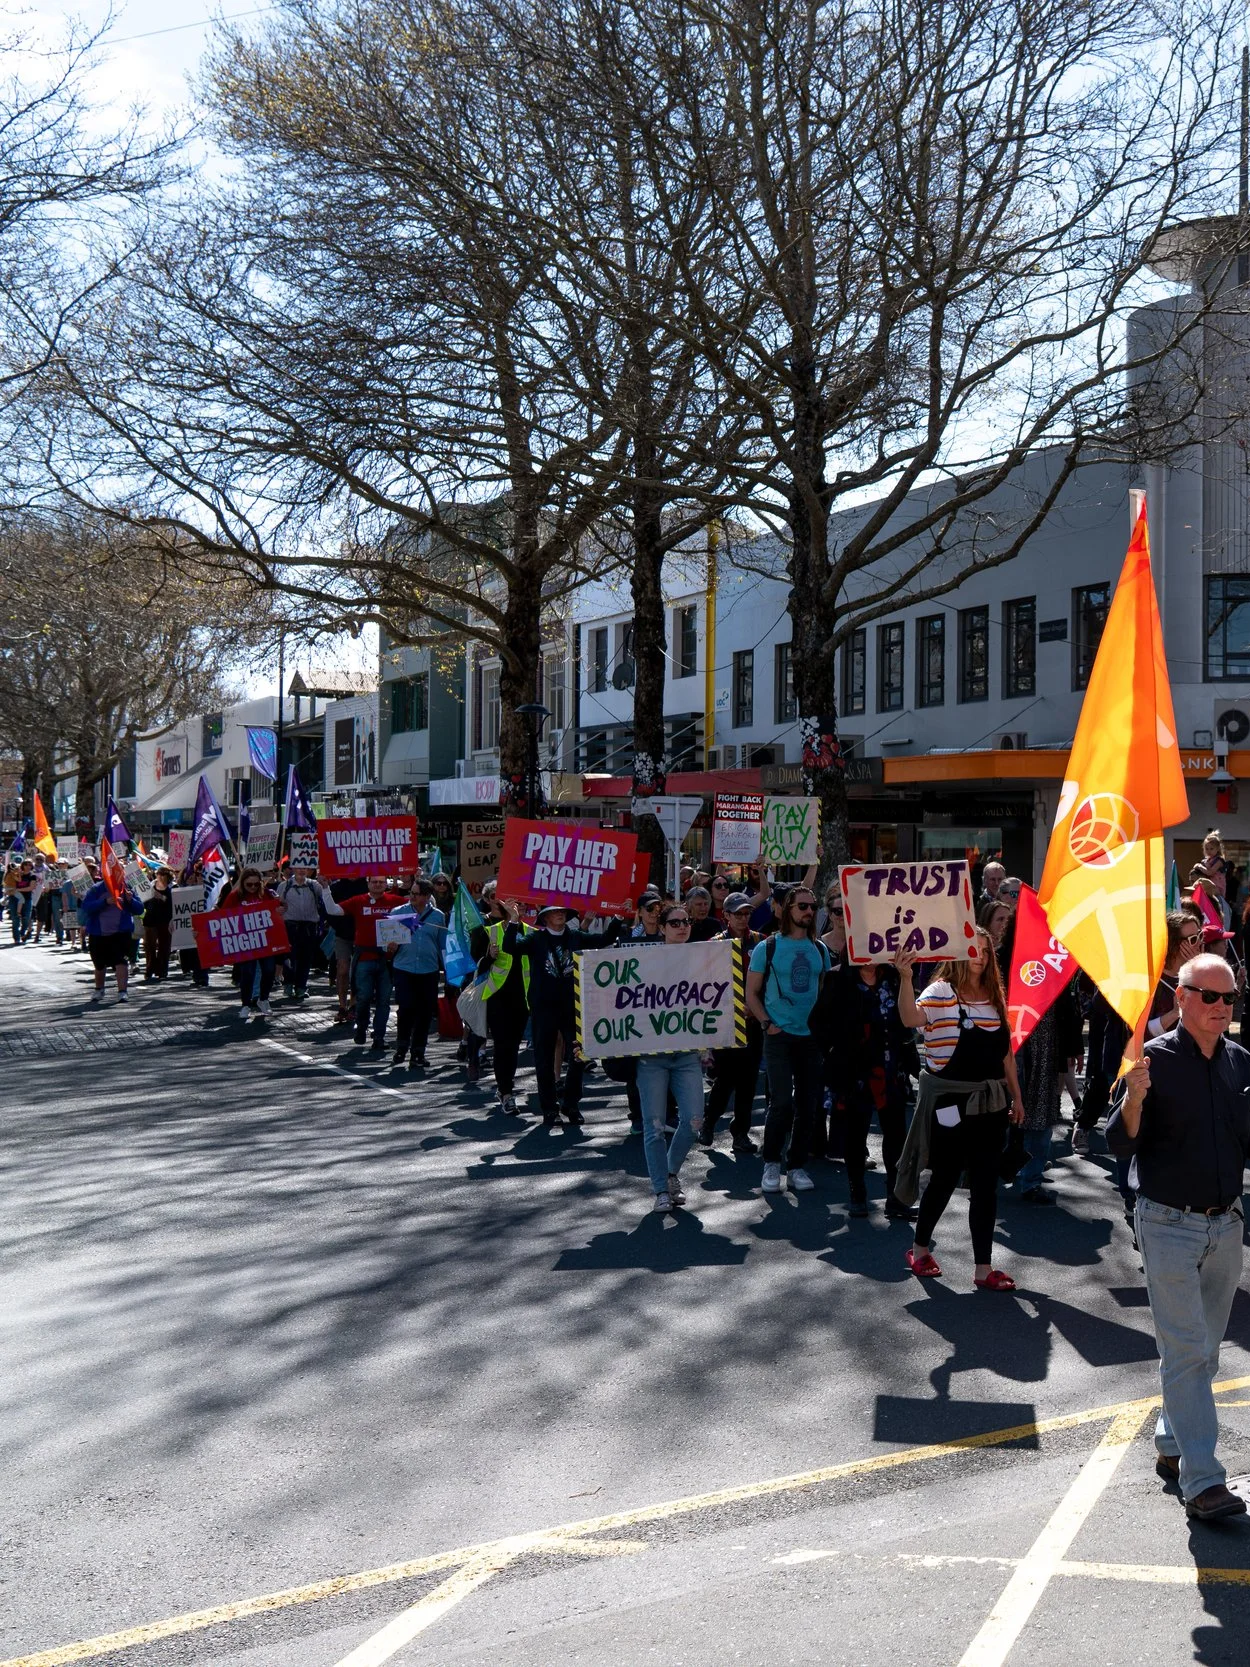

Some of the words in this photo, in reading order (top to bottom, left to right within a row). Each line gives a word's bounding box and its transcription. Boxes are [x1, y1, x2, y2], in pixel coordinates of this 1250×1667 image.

[718, 794, 739, 802] FIGHT
[742, 795, 761, 803] BACK
[718, 810, 760, 819] TOGETHER
[772, 803, 809, 825] PAY
[268, 841, 276, 849] US
[326, 828, 383, 849] WOMEN
[386, 828, 412, 845] ARE
[466, 840, 490, 849] ONE
[246, 852, 262, 865] PAY
[263, 850, 274, 862] US
[336, 846, 388, 865] WORTH
[391, 845, 404, 861] IT
[468, 855, 497, 867] LEAP
[525, 832, 573, 863] PAY
[574, 839, 619, 870] HER
[533, 862, 603, 897] RIGHT
[864, 862, 966, 897] TRUST
[209, 916, 240, 938] PAY
[243, 909, 273, 932] HER
[221, 929, 268, 955] RIGHT
[868, 926, 949, 955] DEAD
[594, 958, 641, 987] OUR
[615, 980, 730, 1009] DEMOCRACY
[593, 1013, 643, 1044] OUR
